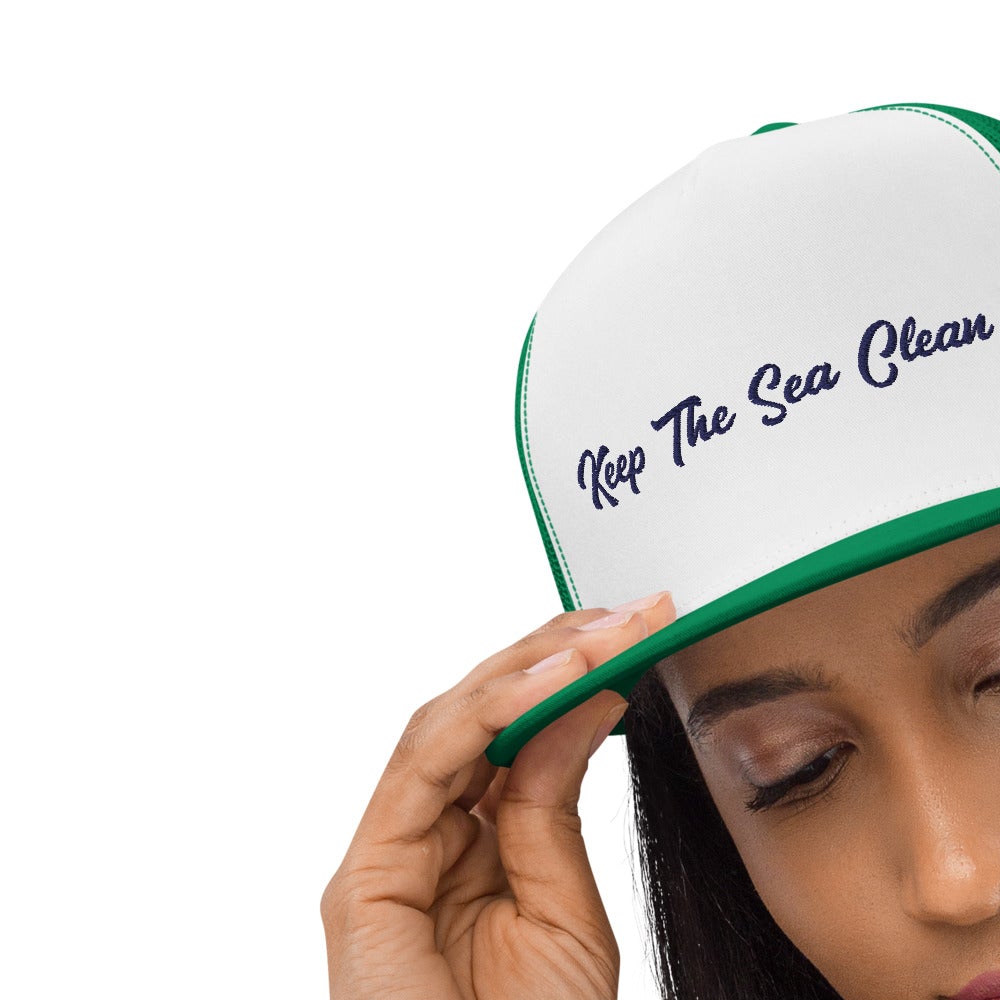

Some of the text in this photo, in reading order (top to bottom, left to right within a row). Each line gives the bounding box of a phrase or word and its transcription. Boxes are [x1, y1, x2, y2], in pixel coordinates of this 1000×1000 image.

[577, 313, 994, 510] Keep The Sea Clean
